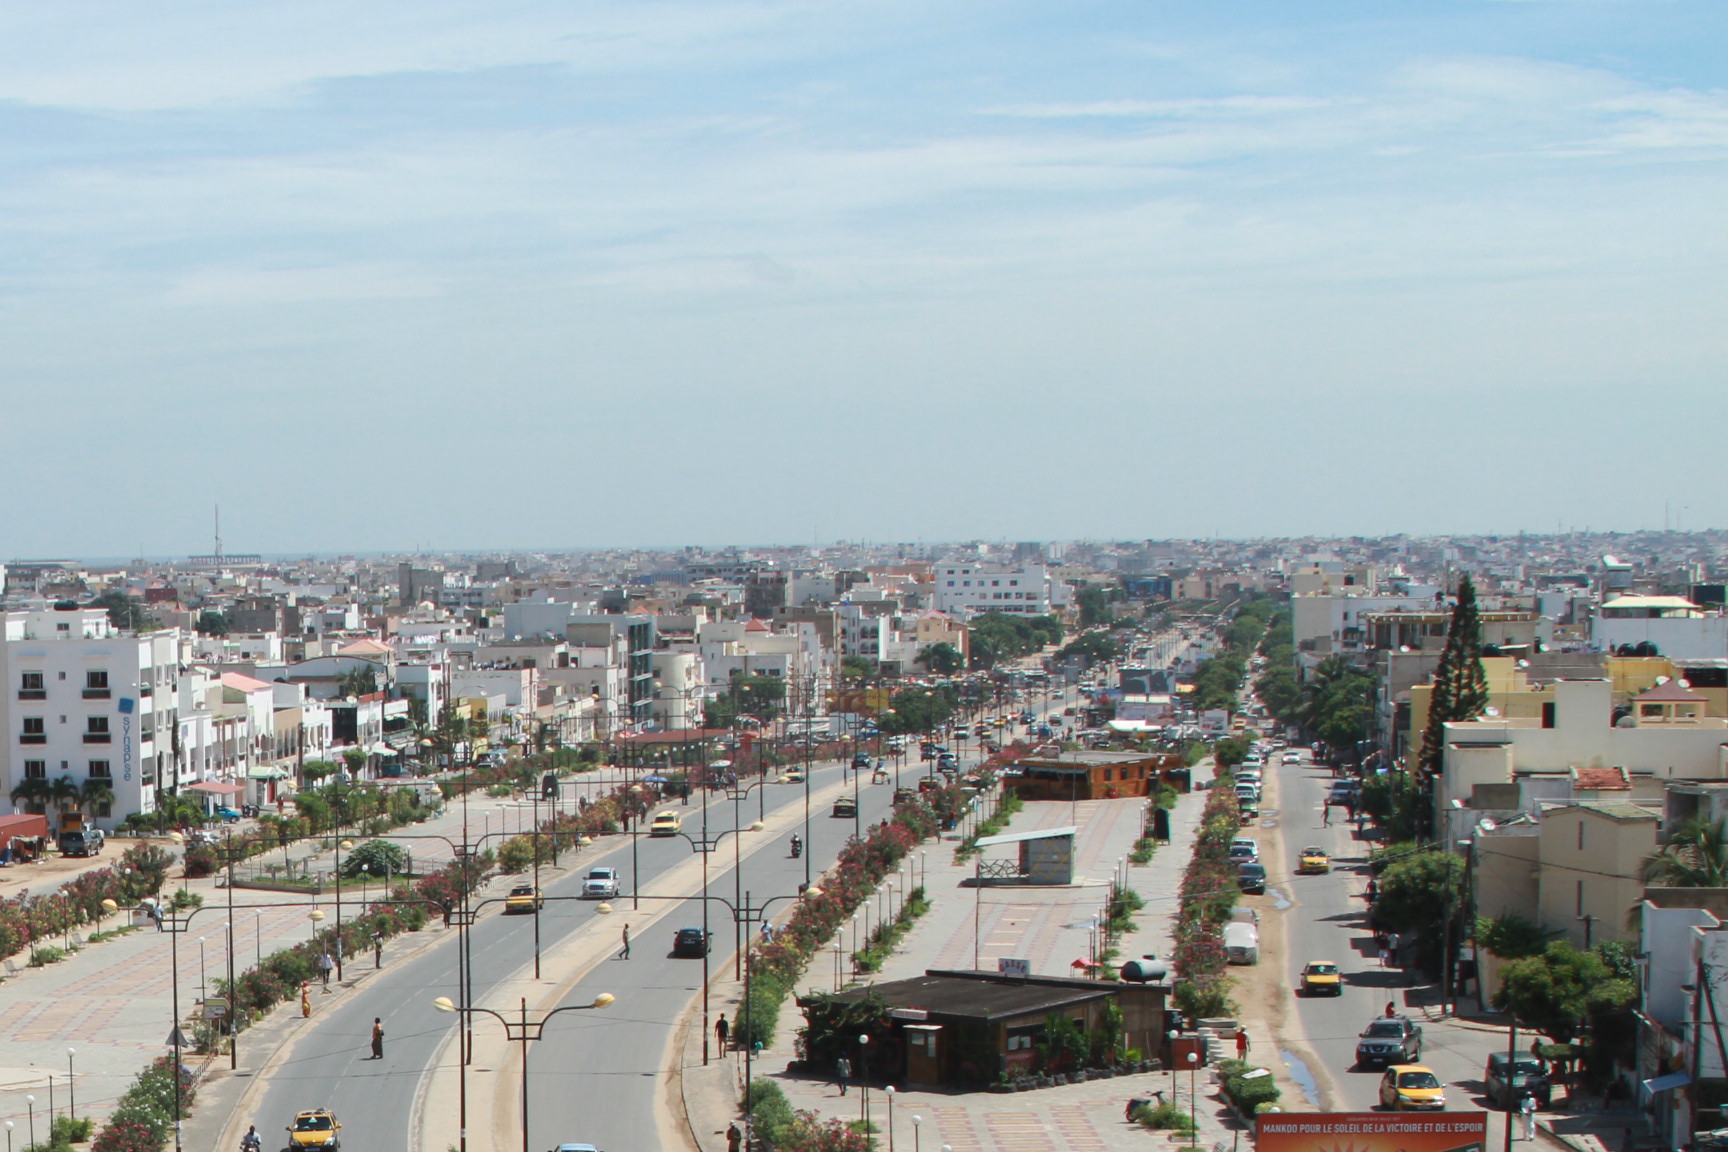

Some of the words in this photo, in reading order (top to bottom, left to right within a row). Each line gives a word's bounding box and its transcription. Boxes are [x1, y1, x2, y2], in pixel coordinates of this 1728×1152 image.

[123, 716, 132, 782] synapse
[1300, 1124, 1321, 1133] POUR
[1323, 1124, 1332, 1133] LE
[1334, 1123, 1361, 1133] SOLEIL
[1363, 1123, 1373, 1133] DE
[1375, 1123, 1385, 1133] LA
[1387, 1123, 1422, 1132] VICTOIRE
[1424, 1123, 1433, 1132] ET
[1436, 1123, 1446, 1132] DE
[1448, 1122, 1484, 1132] L'ESPOIR
